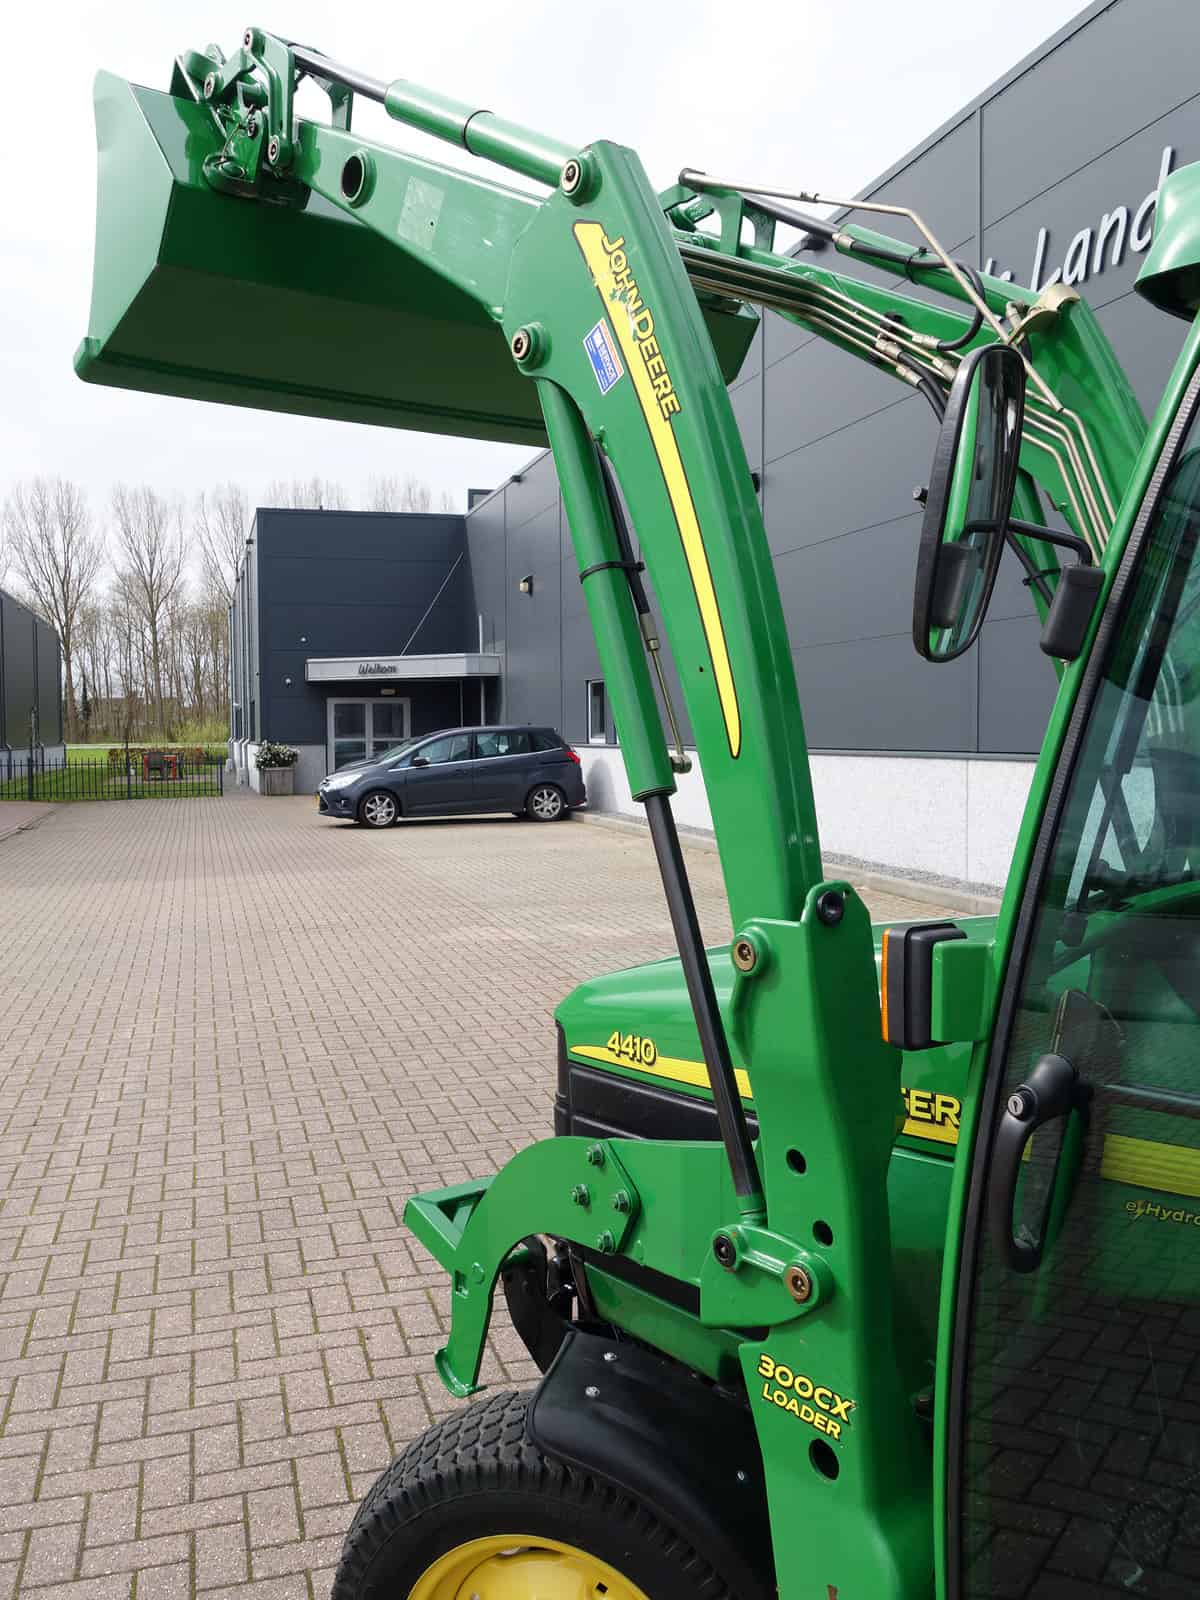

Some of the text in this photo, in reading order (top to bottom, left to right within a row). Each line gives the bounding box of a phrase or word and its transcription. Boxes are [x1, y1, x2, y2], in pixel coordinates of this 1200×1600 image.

[601, 236, 681, 420] JOHN DEERE
[607, 1031, 656, 1065] 4410
[901, 1087, 962, 1126] ER
[758, 1353, 852, 1423] 300CX
[763, 1383, 841, 1440] LOADER
